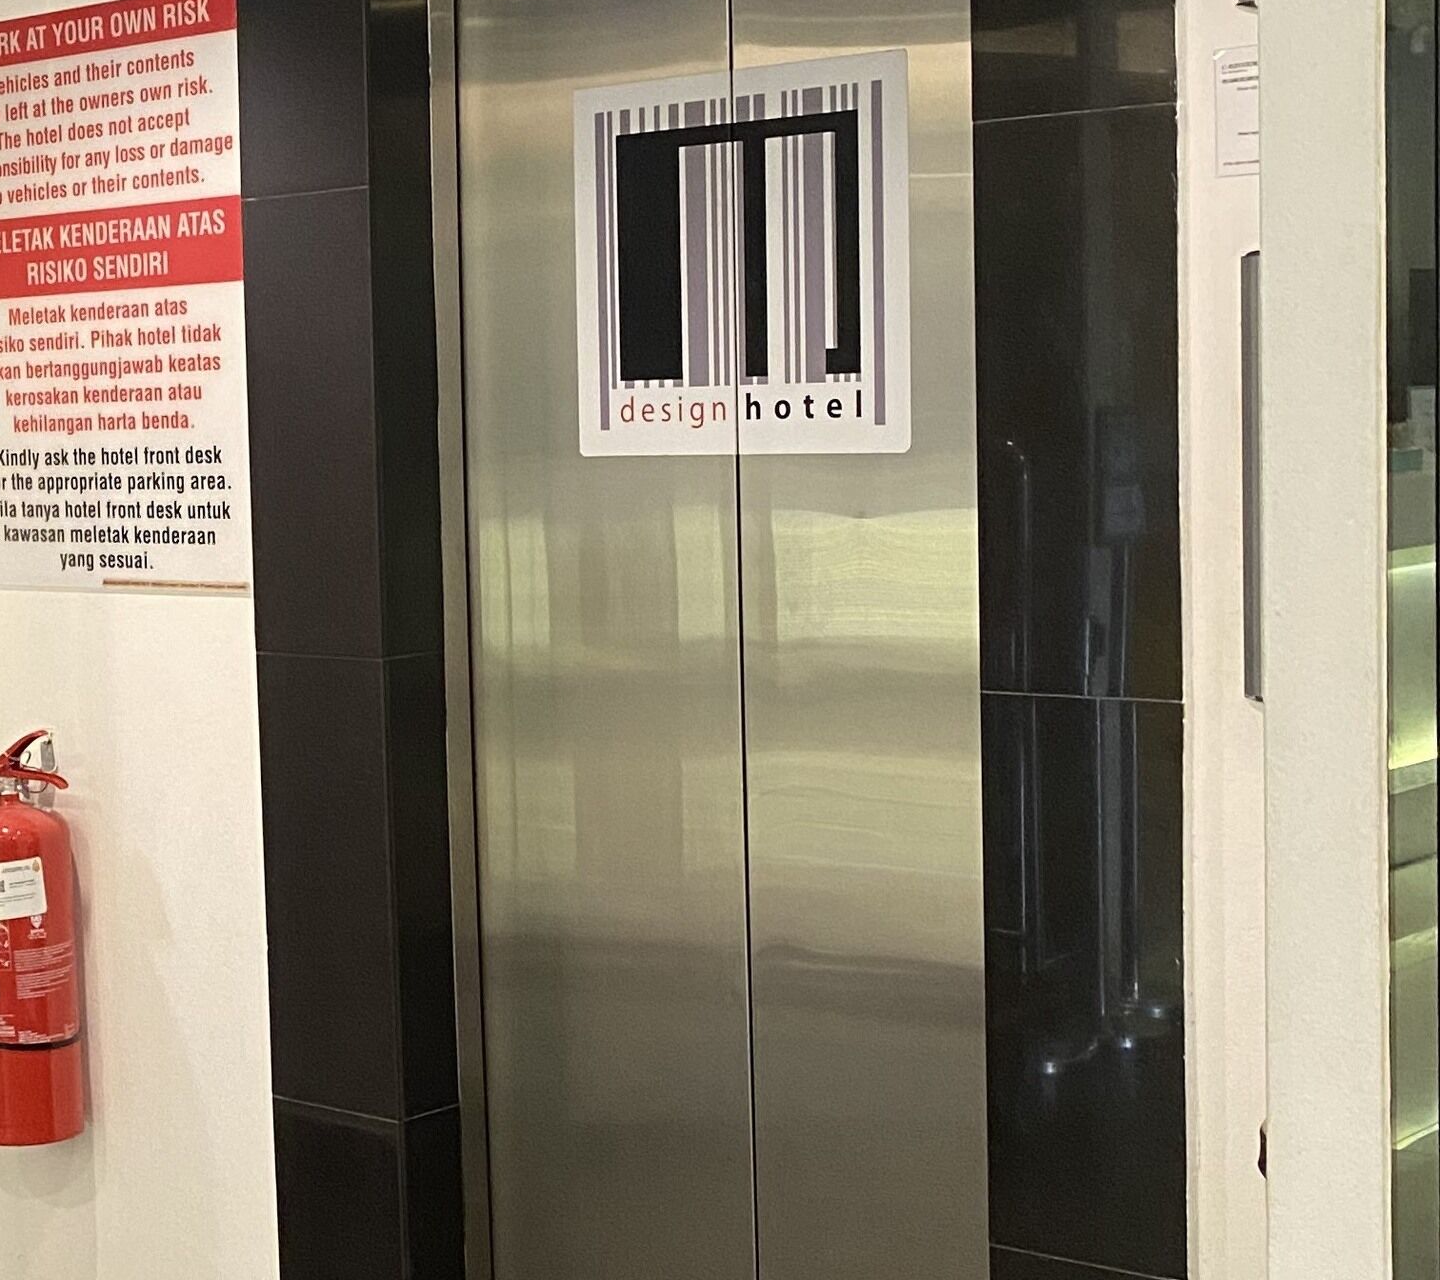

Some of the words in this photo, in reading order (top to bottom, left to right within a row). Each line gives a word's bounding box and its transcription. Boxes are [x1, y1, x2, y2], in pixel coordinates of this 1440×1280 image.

[27, 25, 46, 51] AT
[52, 16, 103, 46] YOUR
[111, 7, 156, 37] OWN
[54, 66, 80, 86] and
[86, 60, 121, 82] their
[127, 50, 194, 75] contents
[6, 102, 28, 122] left
[33, 99, 46, 117] at
[51, 96, 73, 115] the
[80, 90, 134, 111] owners
[140, 85, 171, 102] own
[178, 75, 212, 97] risk.
[26, 125, 62, 146] hotel
[68, 123, 103, 141] does
[109, 116, 132, 136] not
[138, 108, 189, 131] accept
[61, 152, 80, 170] for
[85, 151, 110, 169] any
[116, 145, 145, 163] loss
[150, 144, 165, 159] or
[170, 135, 233, 158] damage
[7, 182, 67, 203] vehicles
[73, 182, 87, 196] or
[92, 174, 127, 194] their
[133, 166, 204, 189] contents.
[60, 215, 170, 248] KENDERAAN
[178, 209, 225, 237] ATAS
[27, 258, 87, 285] RISIKO
[93, 251, 168, 280] SENDIRI
[9, 305, 65, 325] Meletak
[71, 302, 148, 322] kenderaan
[155, 299, 187, 316] atas
[30, 332, 84, 351] sendiri.
[91, 329, 132, 348] Pihak
[138, 326, 175, 345] hotel
[182, 324, 221, 343] tidak
[26, 355, 162, 381] bertanggungjawab
[169, 354, 220, 372] keatas
[6, 387, 78, 406] kerosakan
[83, 385, 162, 403] kenderaan
[169, 384, 201, 400] atau
[620, 396, 727, 428] design
[745, 389, 862, 421] hotel
[14, 415, 92, 435] kehilangan
[98, 413, 136, 430] harta
[142, 412, 196, 430] benda.
[45, 449, 69, 466] ask
[73, 448, 95, 465] the
[102, 447, 137, 465] hotel
[144, 447, 180, 464] front
[186, 446, 221, 464] desk
[11, 473, 32, 490] the
[38, 472, 121, 494] appropriate
[128, 472, 184, 494] parking
[191, 475, 231, 489] area.
[22, 501, 59, 522] tanya
[65, 501, 100, 518] hotel
[107, 501, 141, 518] front
[147, 501, 181, 519] desk
[188, 501, 230, 519] untuk
[4, 525, 64, 542] kawasan
[71, 525, 129, 543] meletak
[135, 526, 215, 544] kenderaan
[60, 554, 94, 571] yang
[100, 554, 153, 569] sesuai.
